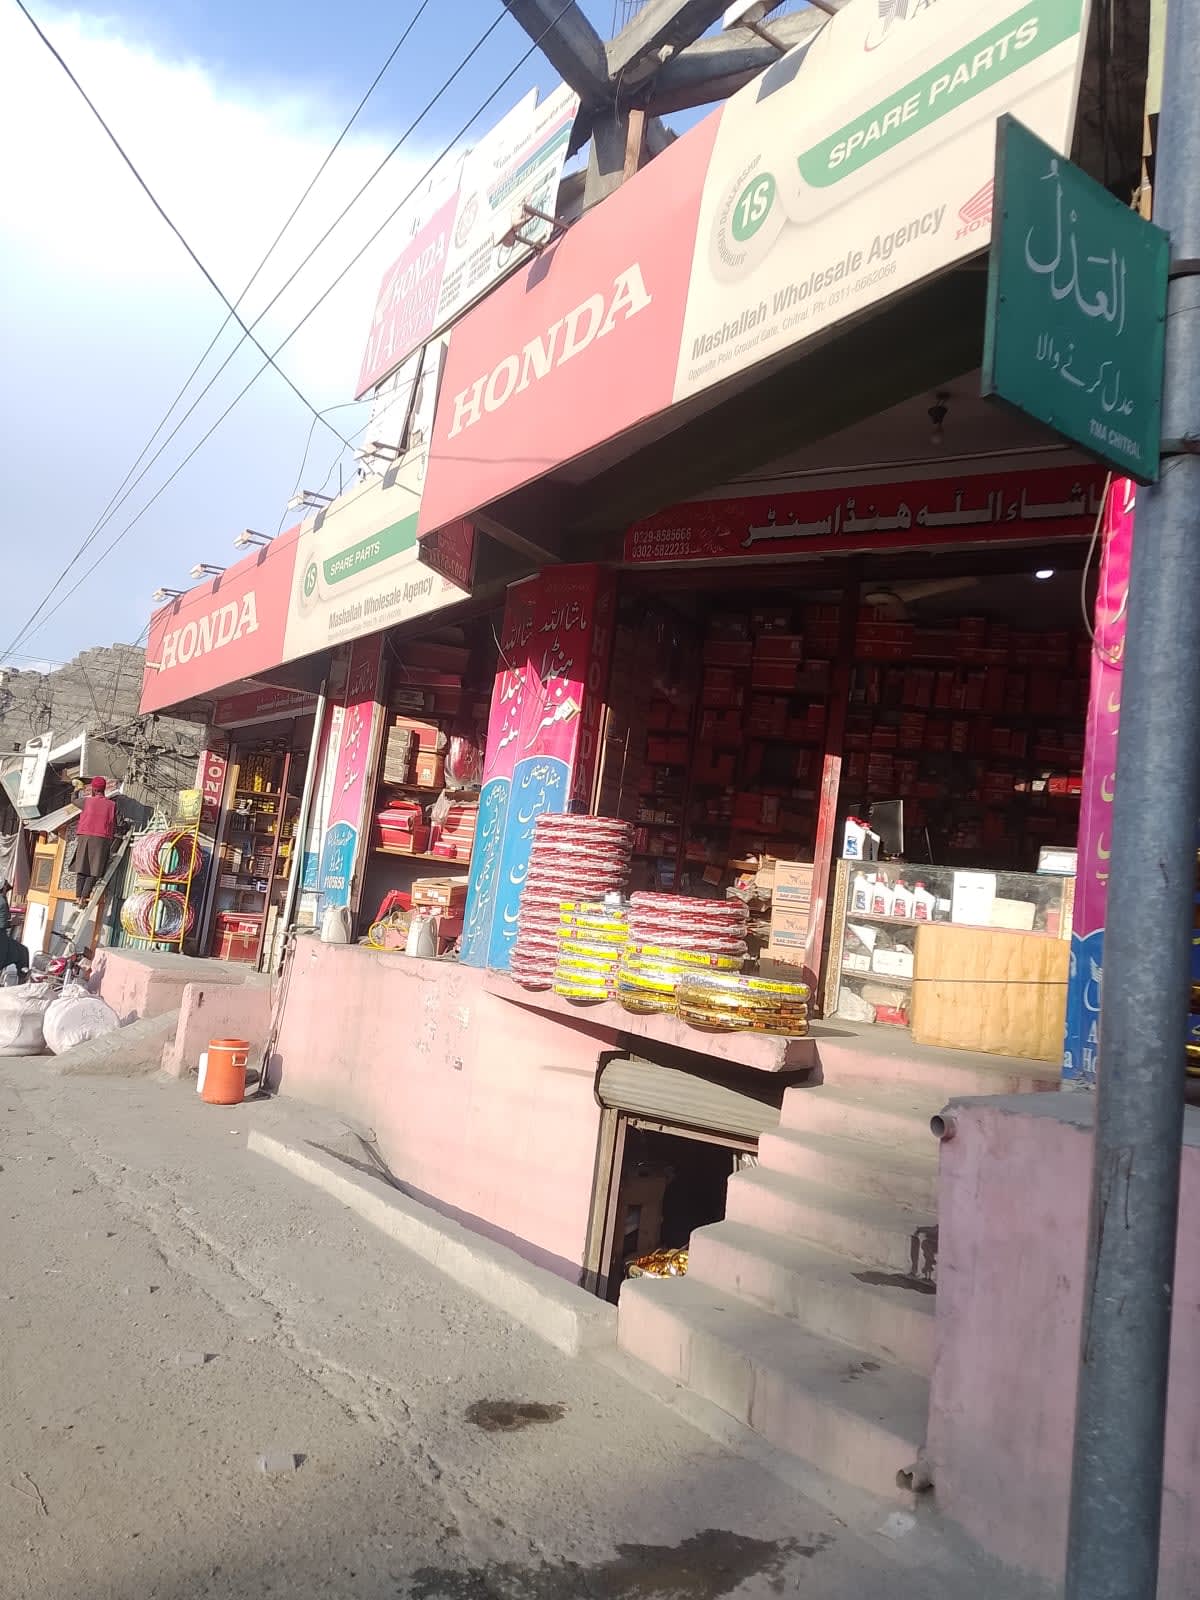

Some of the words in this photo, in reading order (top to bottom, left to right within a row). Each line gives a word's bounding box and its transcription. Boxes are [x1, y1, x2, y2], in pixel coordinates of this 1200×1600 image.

[827, 90, 921, 171] SPARE
[928, 15, 1039, 106] PARTS
[740, 181, 769, 226] 1S
[691, 301, 768, 361] Mashallah
[773, 250, 862, 317] Wholesale
[867, 203, 947, 266] Agency
[447, 261, 653, 441] HONDA
[1108, 428, 1142, 460] CHITRAL
[330, 555, 354, 578] SPARE
[354, 543, 381, 567] PARTS
[158, 591, 260, 674] HONDA
[328, 600, 362, 630] Mashallah
[363, 586, 402, 617] Wholesale
[402, 576, 434, 603] Agency
[202, 752, 226, 824] HONDA
